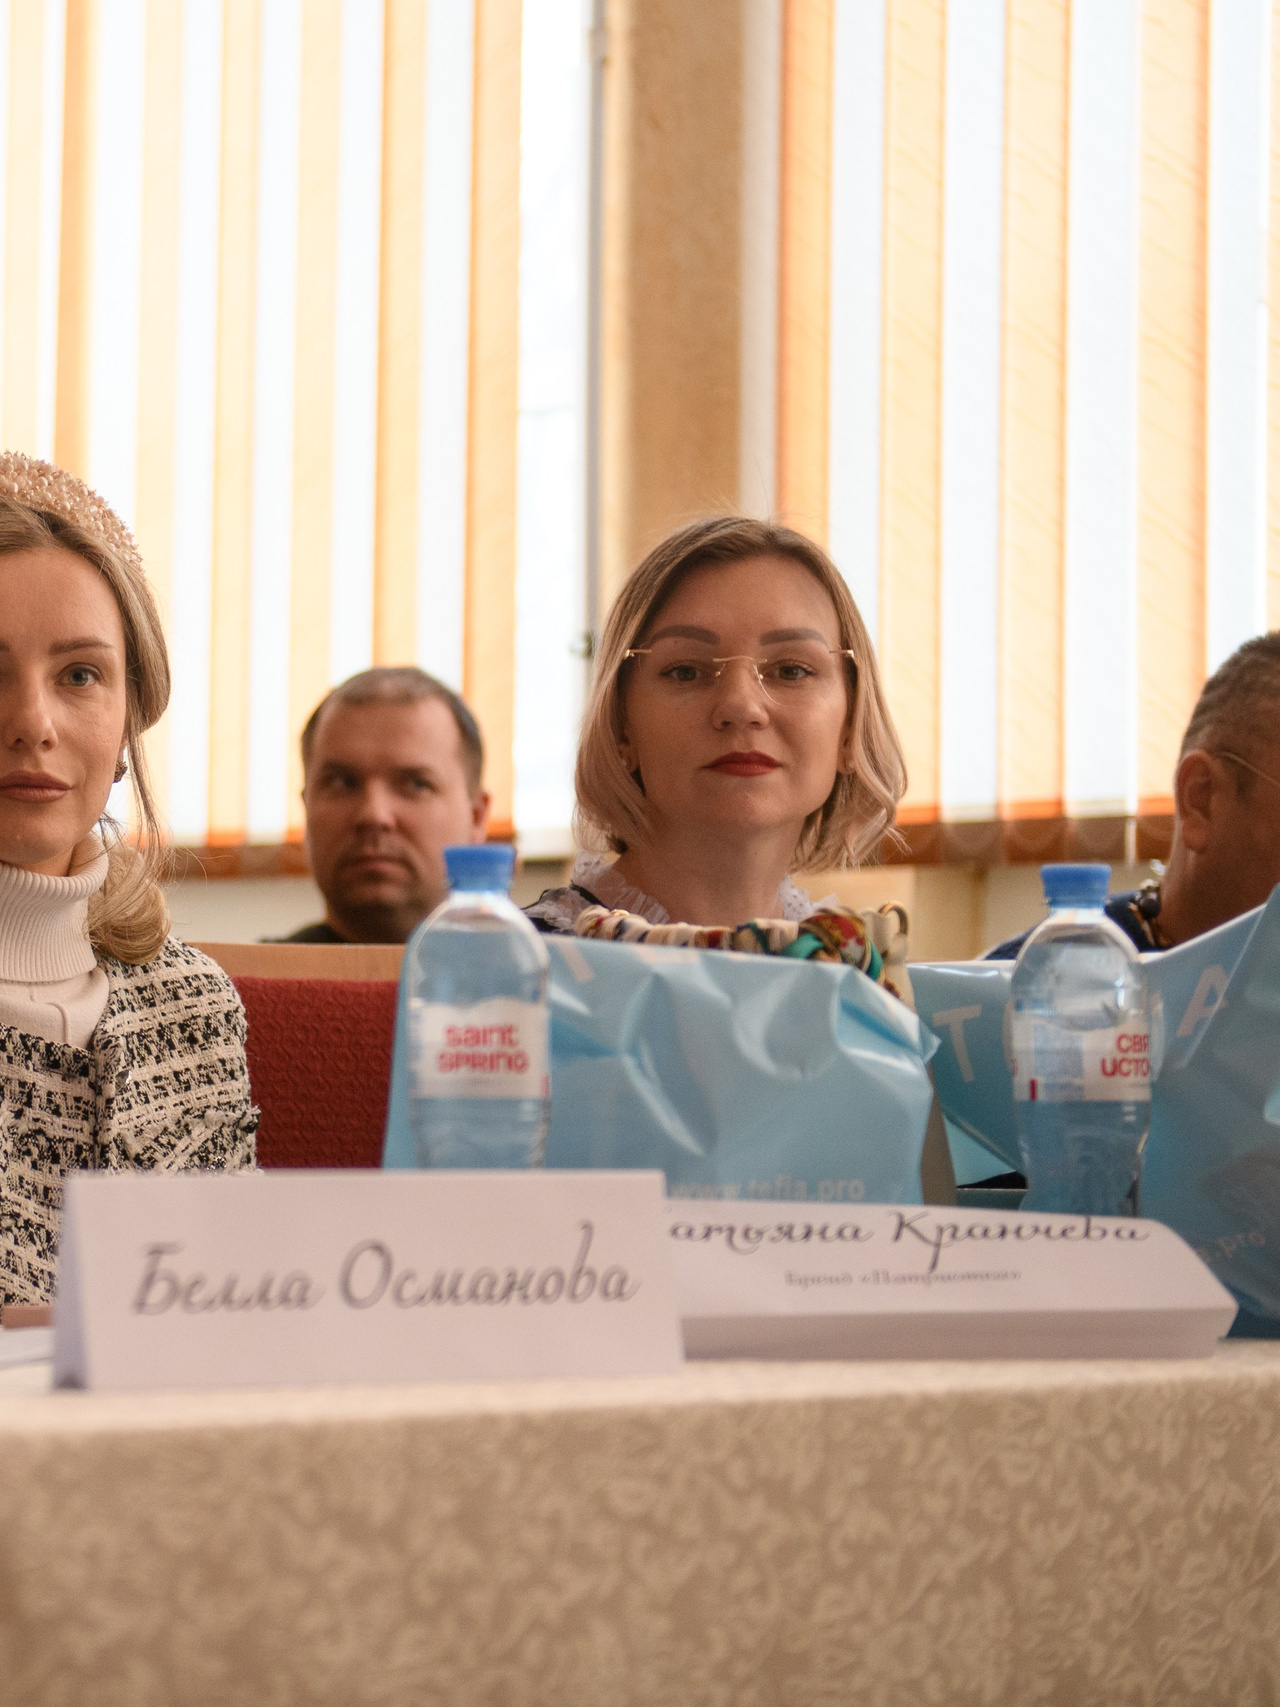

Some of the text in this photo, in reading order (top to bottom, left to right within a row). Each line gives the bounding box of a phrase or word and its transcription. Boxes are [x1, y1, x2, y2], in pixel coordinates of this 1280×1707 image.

[130, 1219, 642, 1316] Белла Османова
[670, 1219, 874, 1255] атьяна
